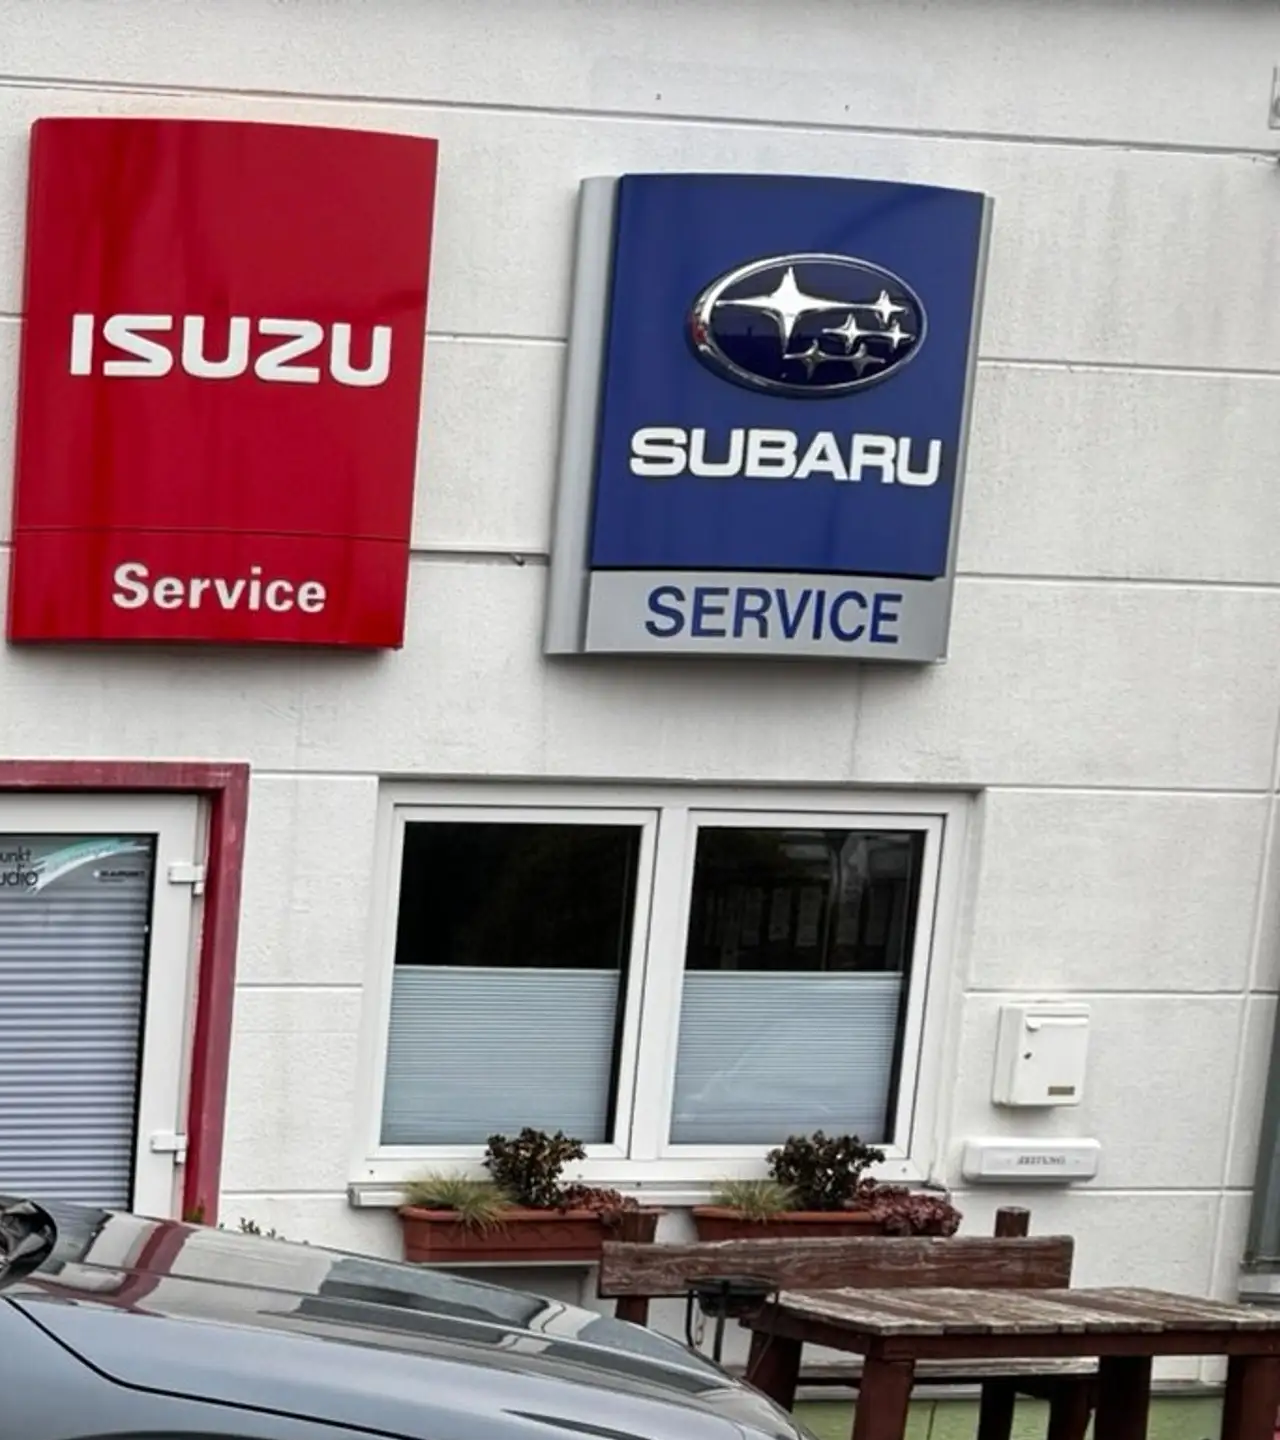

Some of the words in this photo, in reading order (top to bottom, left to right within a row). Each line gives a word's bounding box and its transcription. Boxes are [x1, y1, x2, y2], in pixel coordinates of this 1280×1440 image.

[68, 312, 393, 388] ISUZU
[629, 426, 942, 486] SUBARU
[111, 562, 328, 613] Service
[644, 585, 904, 644] SERVICE
